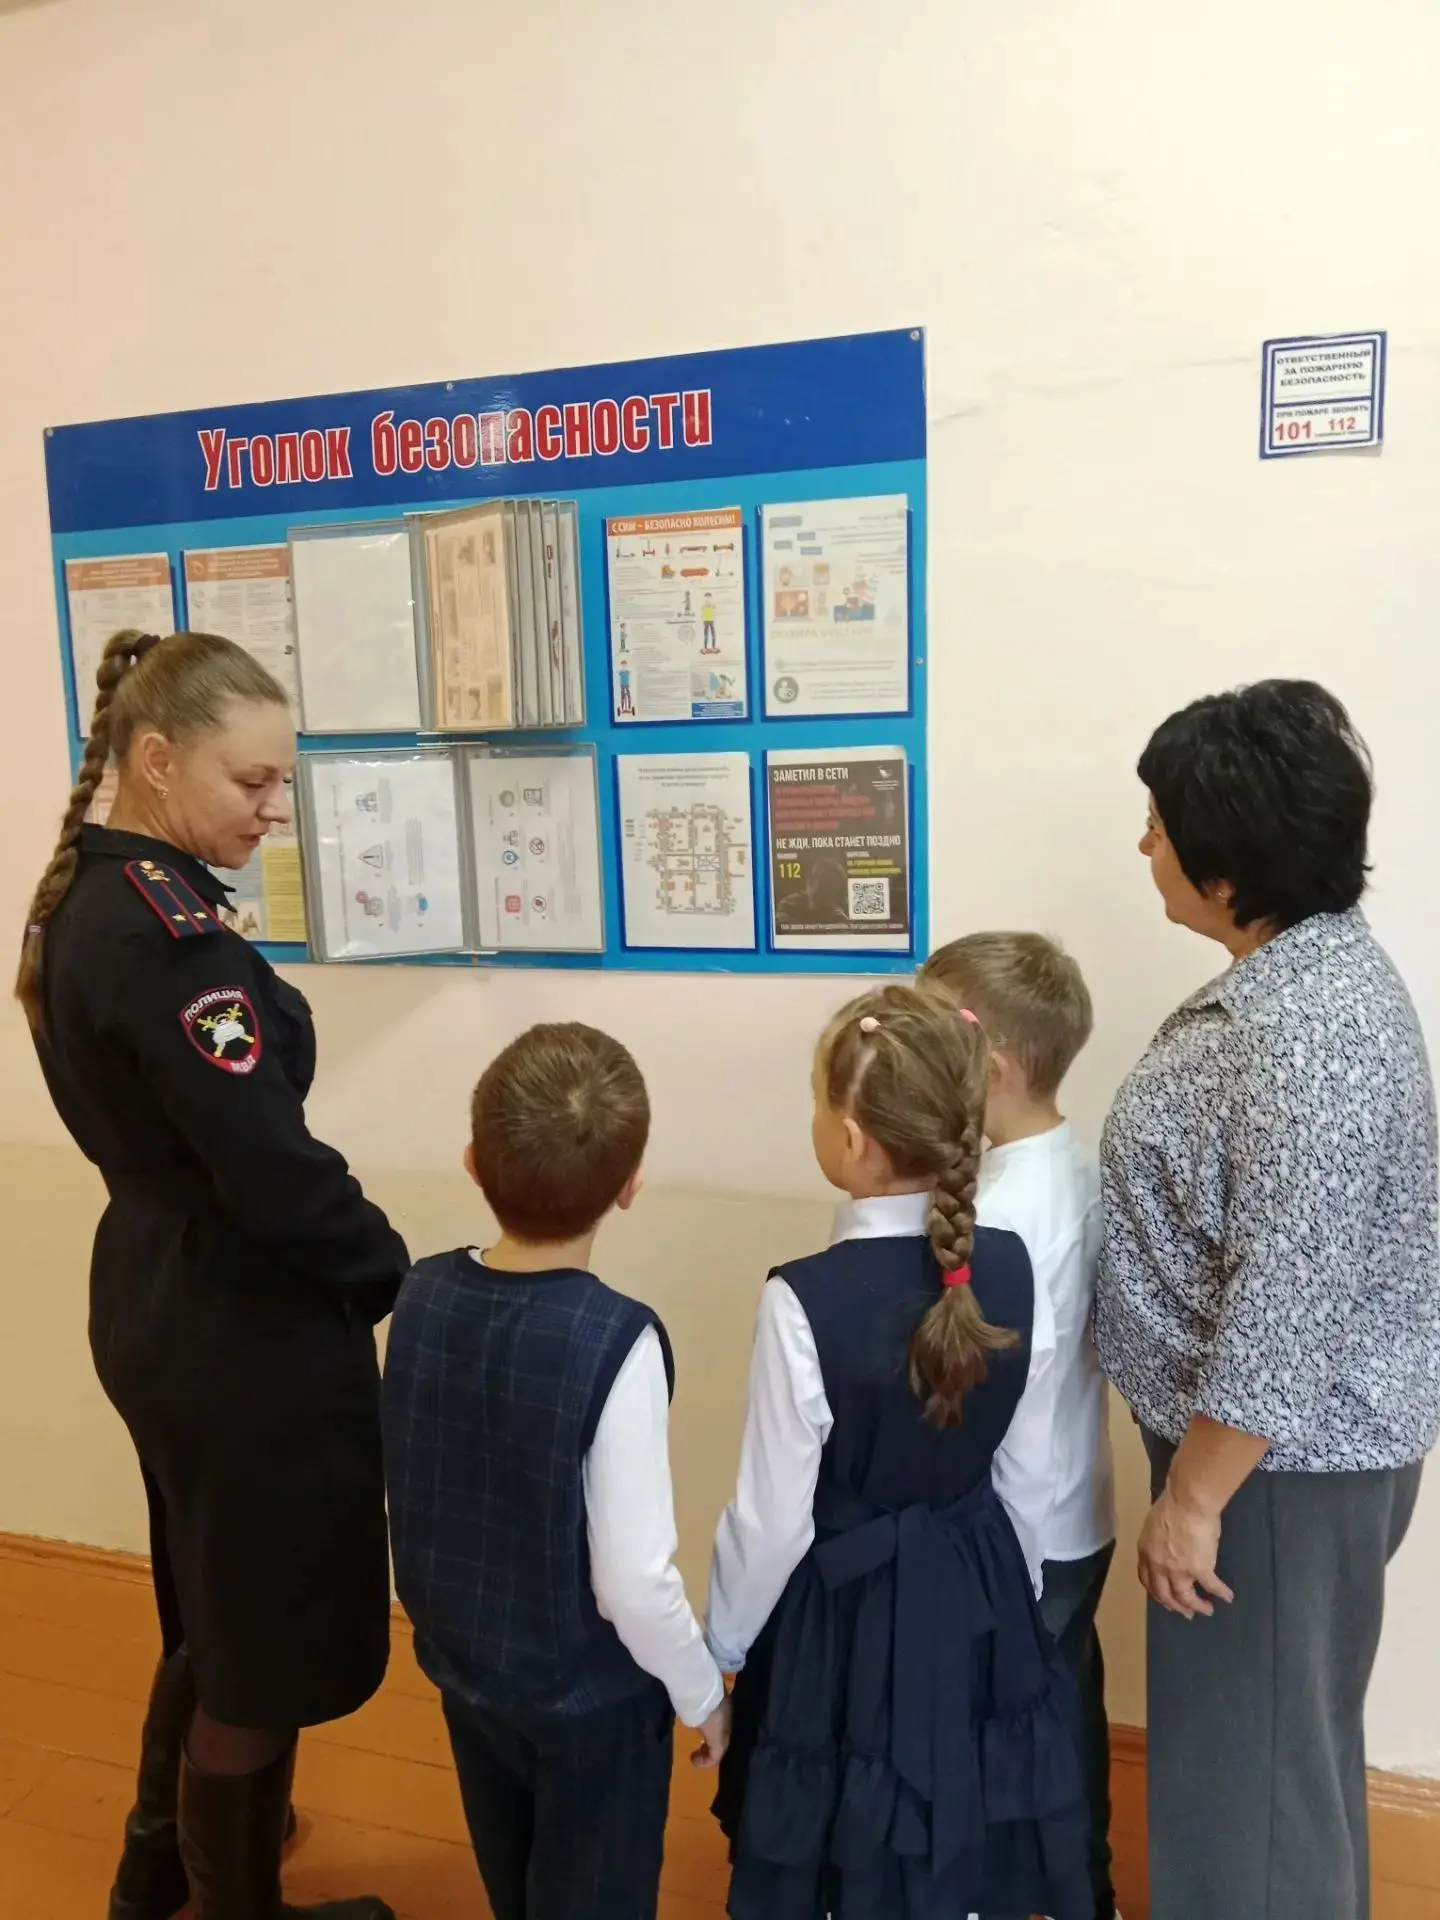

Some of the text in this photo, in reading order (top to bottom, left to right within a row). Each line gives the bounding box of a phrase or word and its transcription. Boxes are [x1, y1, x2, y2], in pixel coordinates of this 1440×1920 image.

[1276, 349, 1371, 364] ОТВЕТСТВЕННЫЙ
[1284, 362, 1364, 376] ЗА ПОЖАРНУЮ
[1280, 373, 1366, 386] БЕЗОПАСНОСТЬ
[1276, 405, 1369, 418] ПРИ ПОЖАРЕ ЗВОНИТЬ
[1275, 416, 1356, 441] 101 112
[197, 388, 713, 491] Уголок безопасности
[611, 523, 618, 533] С
[644, 518, 692, 531] БЕЗОПАСНО
[773, 767, 849, 782] ЗАМЕТИЛ В СЕТИ
[776, 838, 788, 849] НЕ
[812, 837, 834, 848] ПОКА
[834, 836, 865, 848] СТАНЕТ
[866, 835, 901, 847] ПОЗДНО
[778, 862, 801, 879] 112
[184, 989, 244, 1022] ПОЛИЦИЯ
[230, 1054, 256, 1073] МВД
